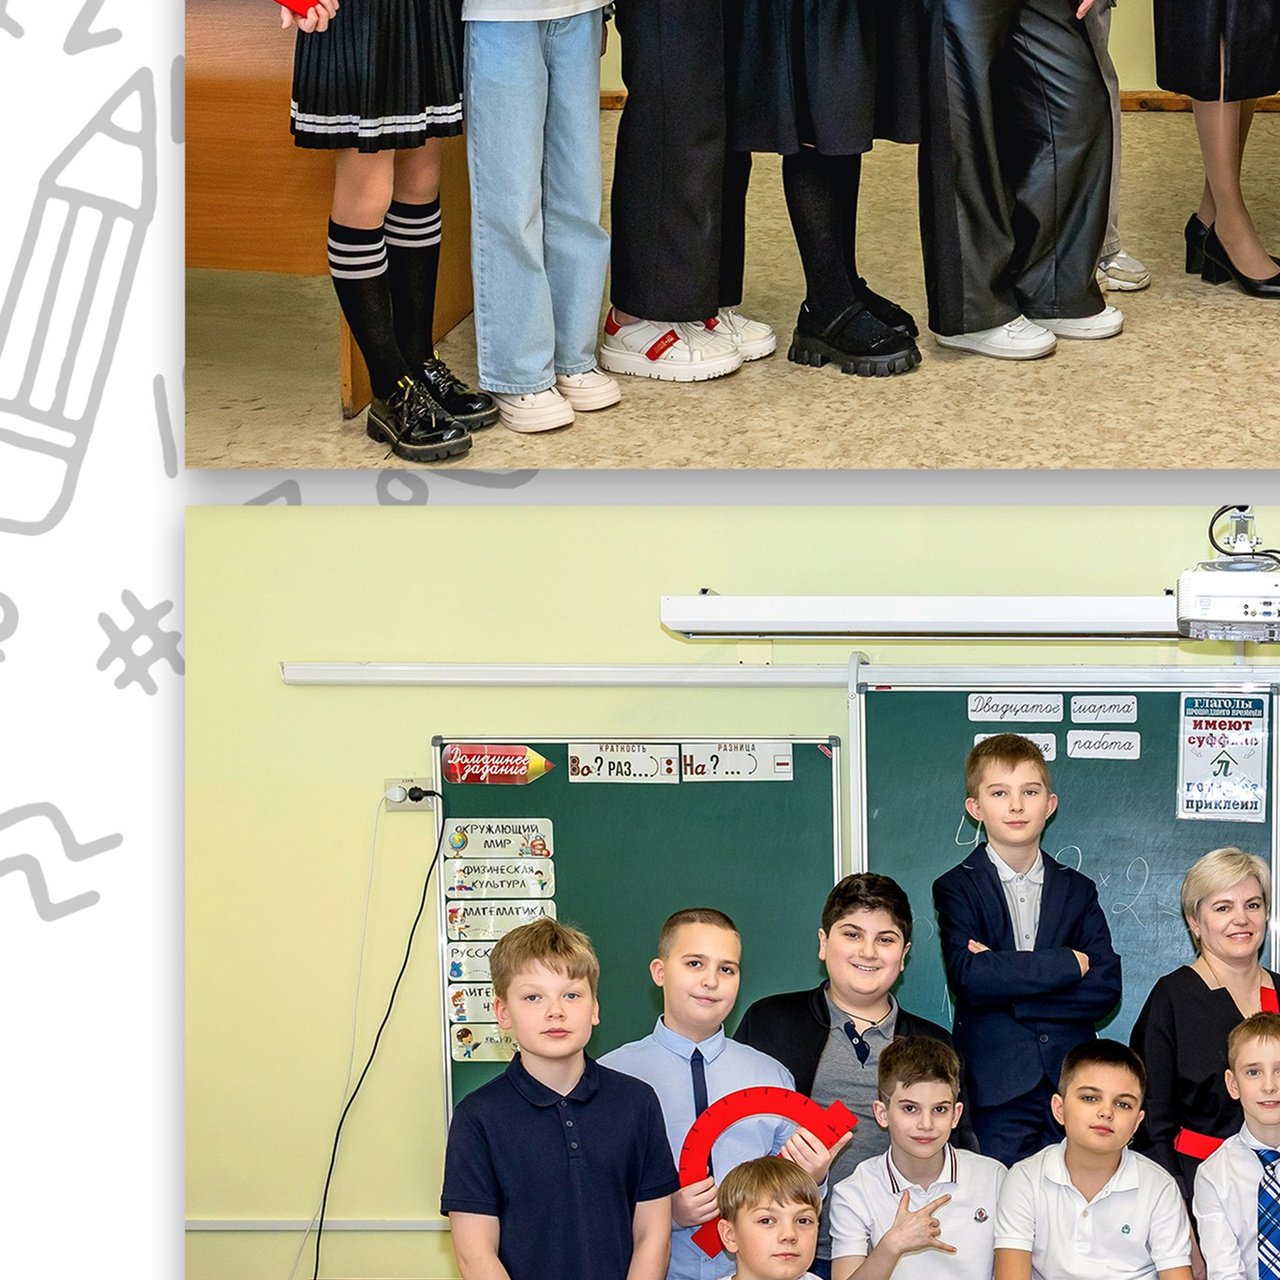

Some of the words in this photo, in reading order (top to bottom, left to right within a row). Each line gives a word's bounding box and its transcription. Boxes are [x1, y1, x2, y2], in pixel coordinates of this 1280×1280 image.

[1194, 699, 1253, 709] глаголы
[1192, 720, 1253, 731] имеют
[599, 744, 647, 753] КРАТНОСТЬ
[717, 743, 757, 752] РАЗНИЦА
[1070, 732, 1134, 756] работа
[447, 747, 530, 765] Домашнее
[462, 763, 528, 780] задание
[1185, 800, 1259, 812] приклеил
[455, 824, 539, 835] ОКРУЖАЮЩИЙ
[483, 839, 512, 849] МИР
[463, 865, 535, 875] ФИЗИЧЕСКАЯ
[472, 880, 527, 889] КУЛЬТУРА
[463, 906, 546, 917] МАТЕМАТИКА
[451, 948, 492, 958] РУССК
